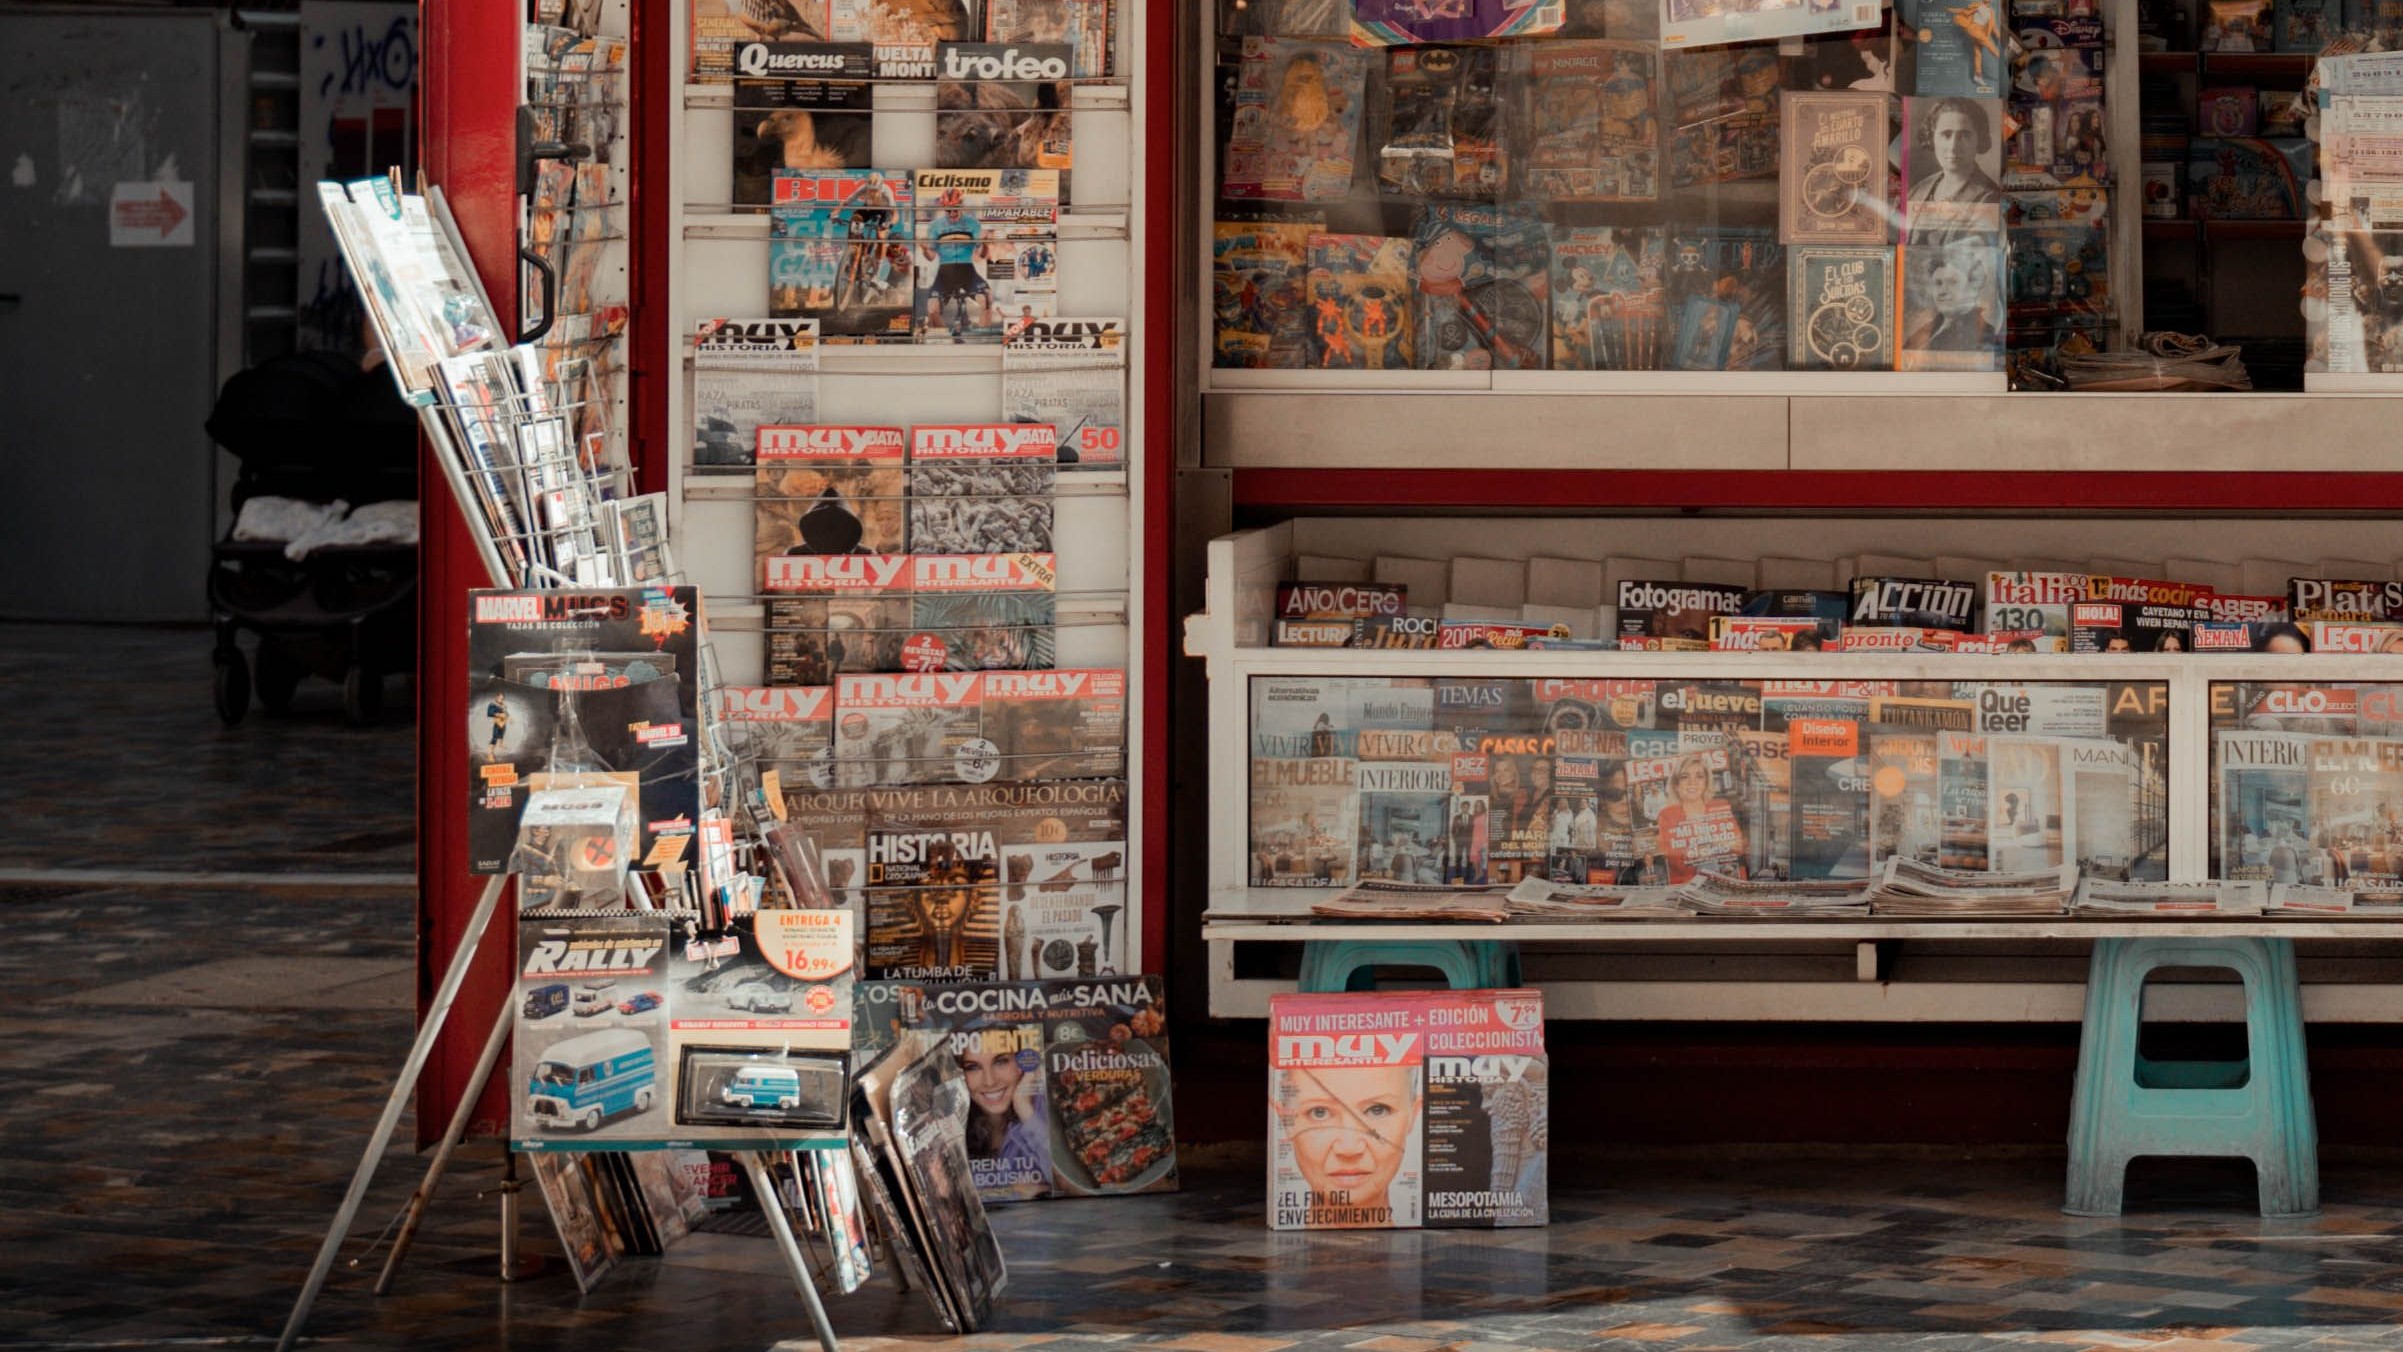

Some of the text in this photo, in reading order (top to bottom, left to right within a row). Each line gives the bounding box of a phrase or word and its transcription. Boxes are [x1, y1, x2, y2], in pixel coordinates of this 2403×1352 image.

[740, 43, 845, 76] Quercus
[880, 63, 936, 77] MONT
[945, 48, 1066, 79] trofeo
[918, 174, 991, 188] Ciclismo
[760, 429, 871, 454] muy
[916, 428, 1023, 453] muy
[1081, 428, 1120, 449] 50
[768, 556, 906, 585] muy
[1019, 554, 1053, 584] EXTRA
[768, 579, 869, 587] HISTORIA
[477, 597, 541, 621] MARVEL
[1619, 581, 1742, 616] Fotogramas
[1995, 608, 2044, 630] 130
[2136, 617, 2161, 627] VIVEN
[2142, 606, 2185, 618] CAYETANO
[536, 622, 547, 630] DE
[1842, 632, 1914, 651] pronto
[840, 675, 977, 704] muy
[985, 673, 1088, 695] muy
[1440, 686, 1502, 705] TEMAS
[1363, 702, 1398, 719] Mundo
[1981, 713, 2031, 732] leer
[1803, 736, 1848, 747] Interior
[1276, 760, 1354, 786] MUEBLE
[872, 785, 1121, 810] VIVE LA ARQUEOLOGÍA
[780, 914, 841, 926] ENTREGA 4
[524, 940, 661, 974] RALLY
[884, 965, 973, 979] LA TUMBA DE
[937, 987, 1048, 1014] COCINA
[1074, 982, 1153, 1007] SANA
[1280, 1014, 1313, 1032] MUY
[1315, 1011, 1410, 1030] INTERESANTE
[1429, 1006, 1489, 1026] EDICIÓN
[1279, 1033, 1419, 1064] muy
[1429, 1029, 1543, 1050] COLECCIONISTA
[1053, 1050, 1160, 1073] Deliciosas
[1429, 1057, 1532, 1083] muy
[1014, 1157, 1035, 1170] TU
[1278, 1190, 1353, 1208] ¿EL FIN DEL
[1429, 1191, 1524, 1208] MESOPOTAMIA
[1278, 1207, 1392, 1226] ENVEJECIMIENTO?
[1429, 1209, 1440, 1219] LA
